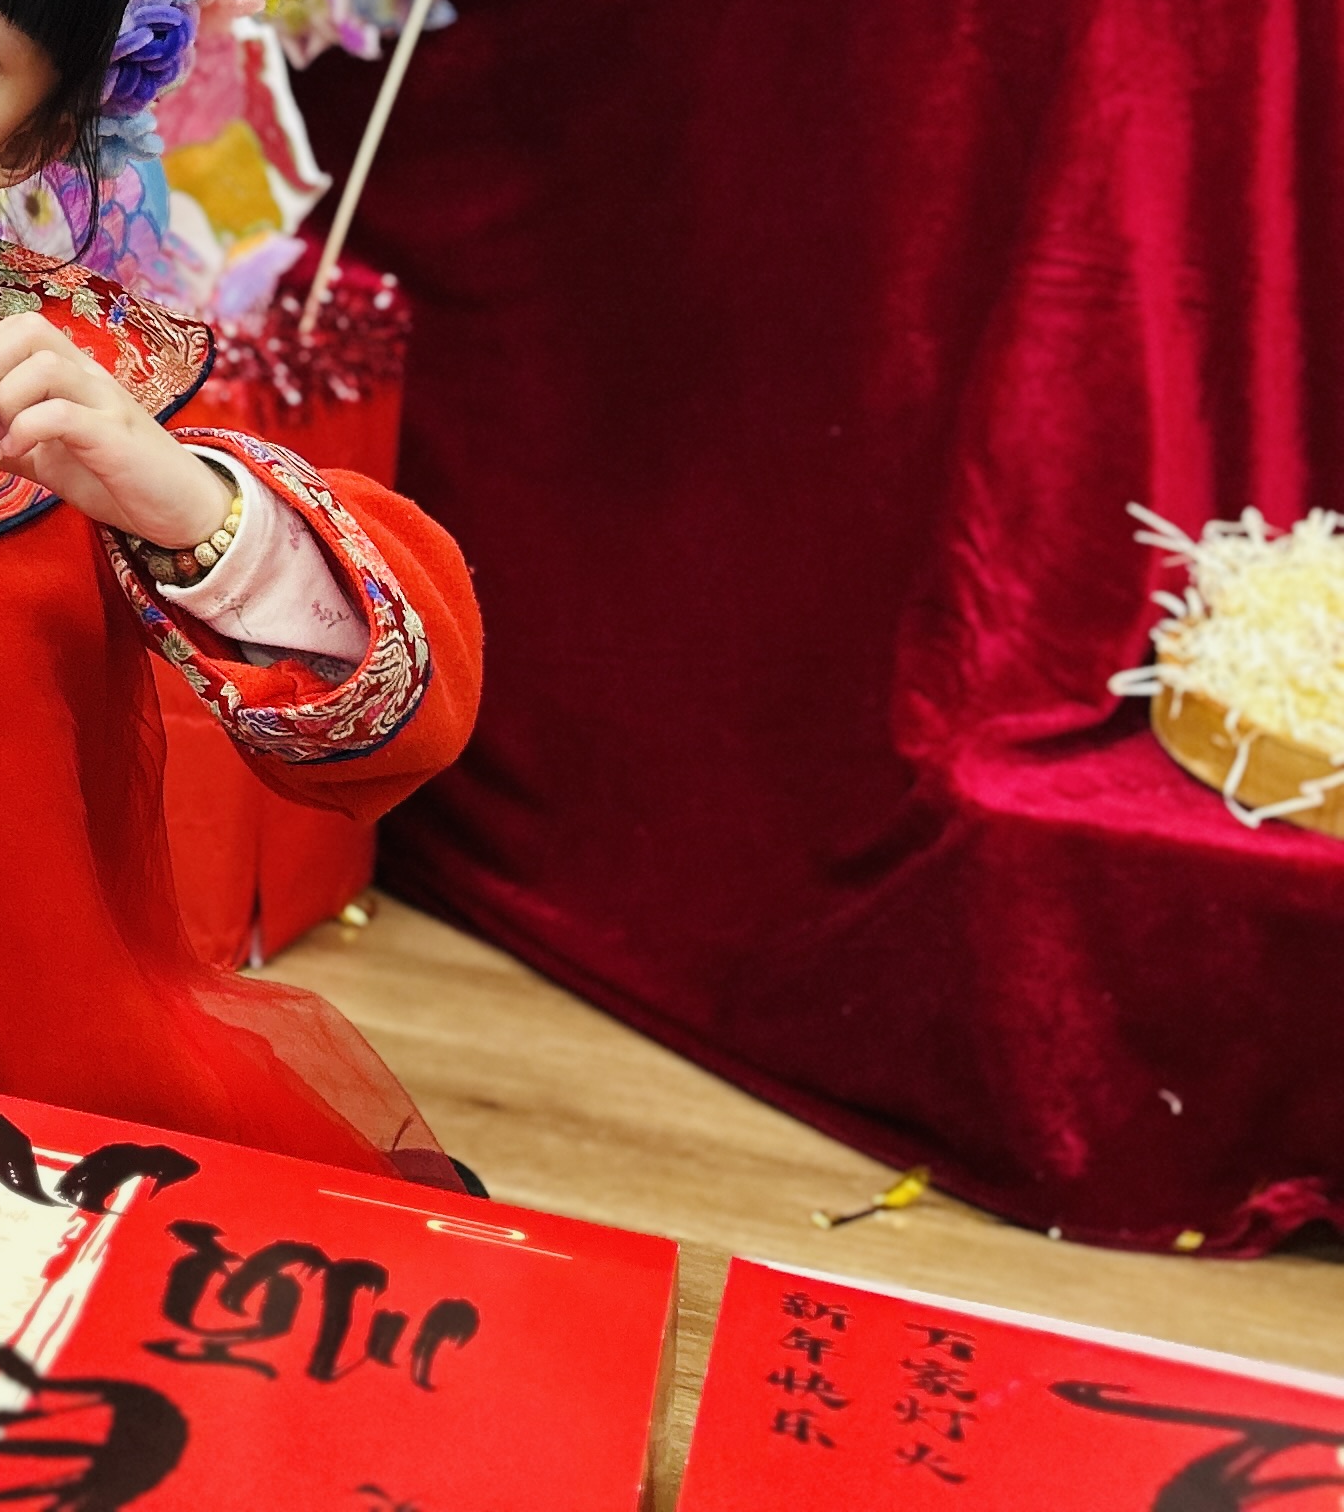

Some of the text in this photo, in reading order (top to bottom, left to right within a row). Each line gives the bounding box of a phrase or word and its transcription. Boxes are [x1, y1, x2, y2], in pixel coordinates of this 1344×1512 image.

[765, 1290, 852, 1450] 新年快乐
[893, 1320, 978, 1485] 万家灯火
